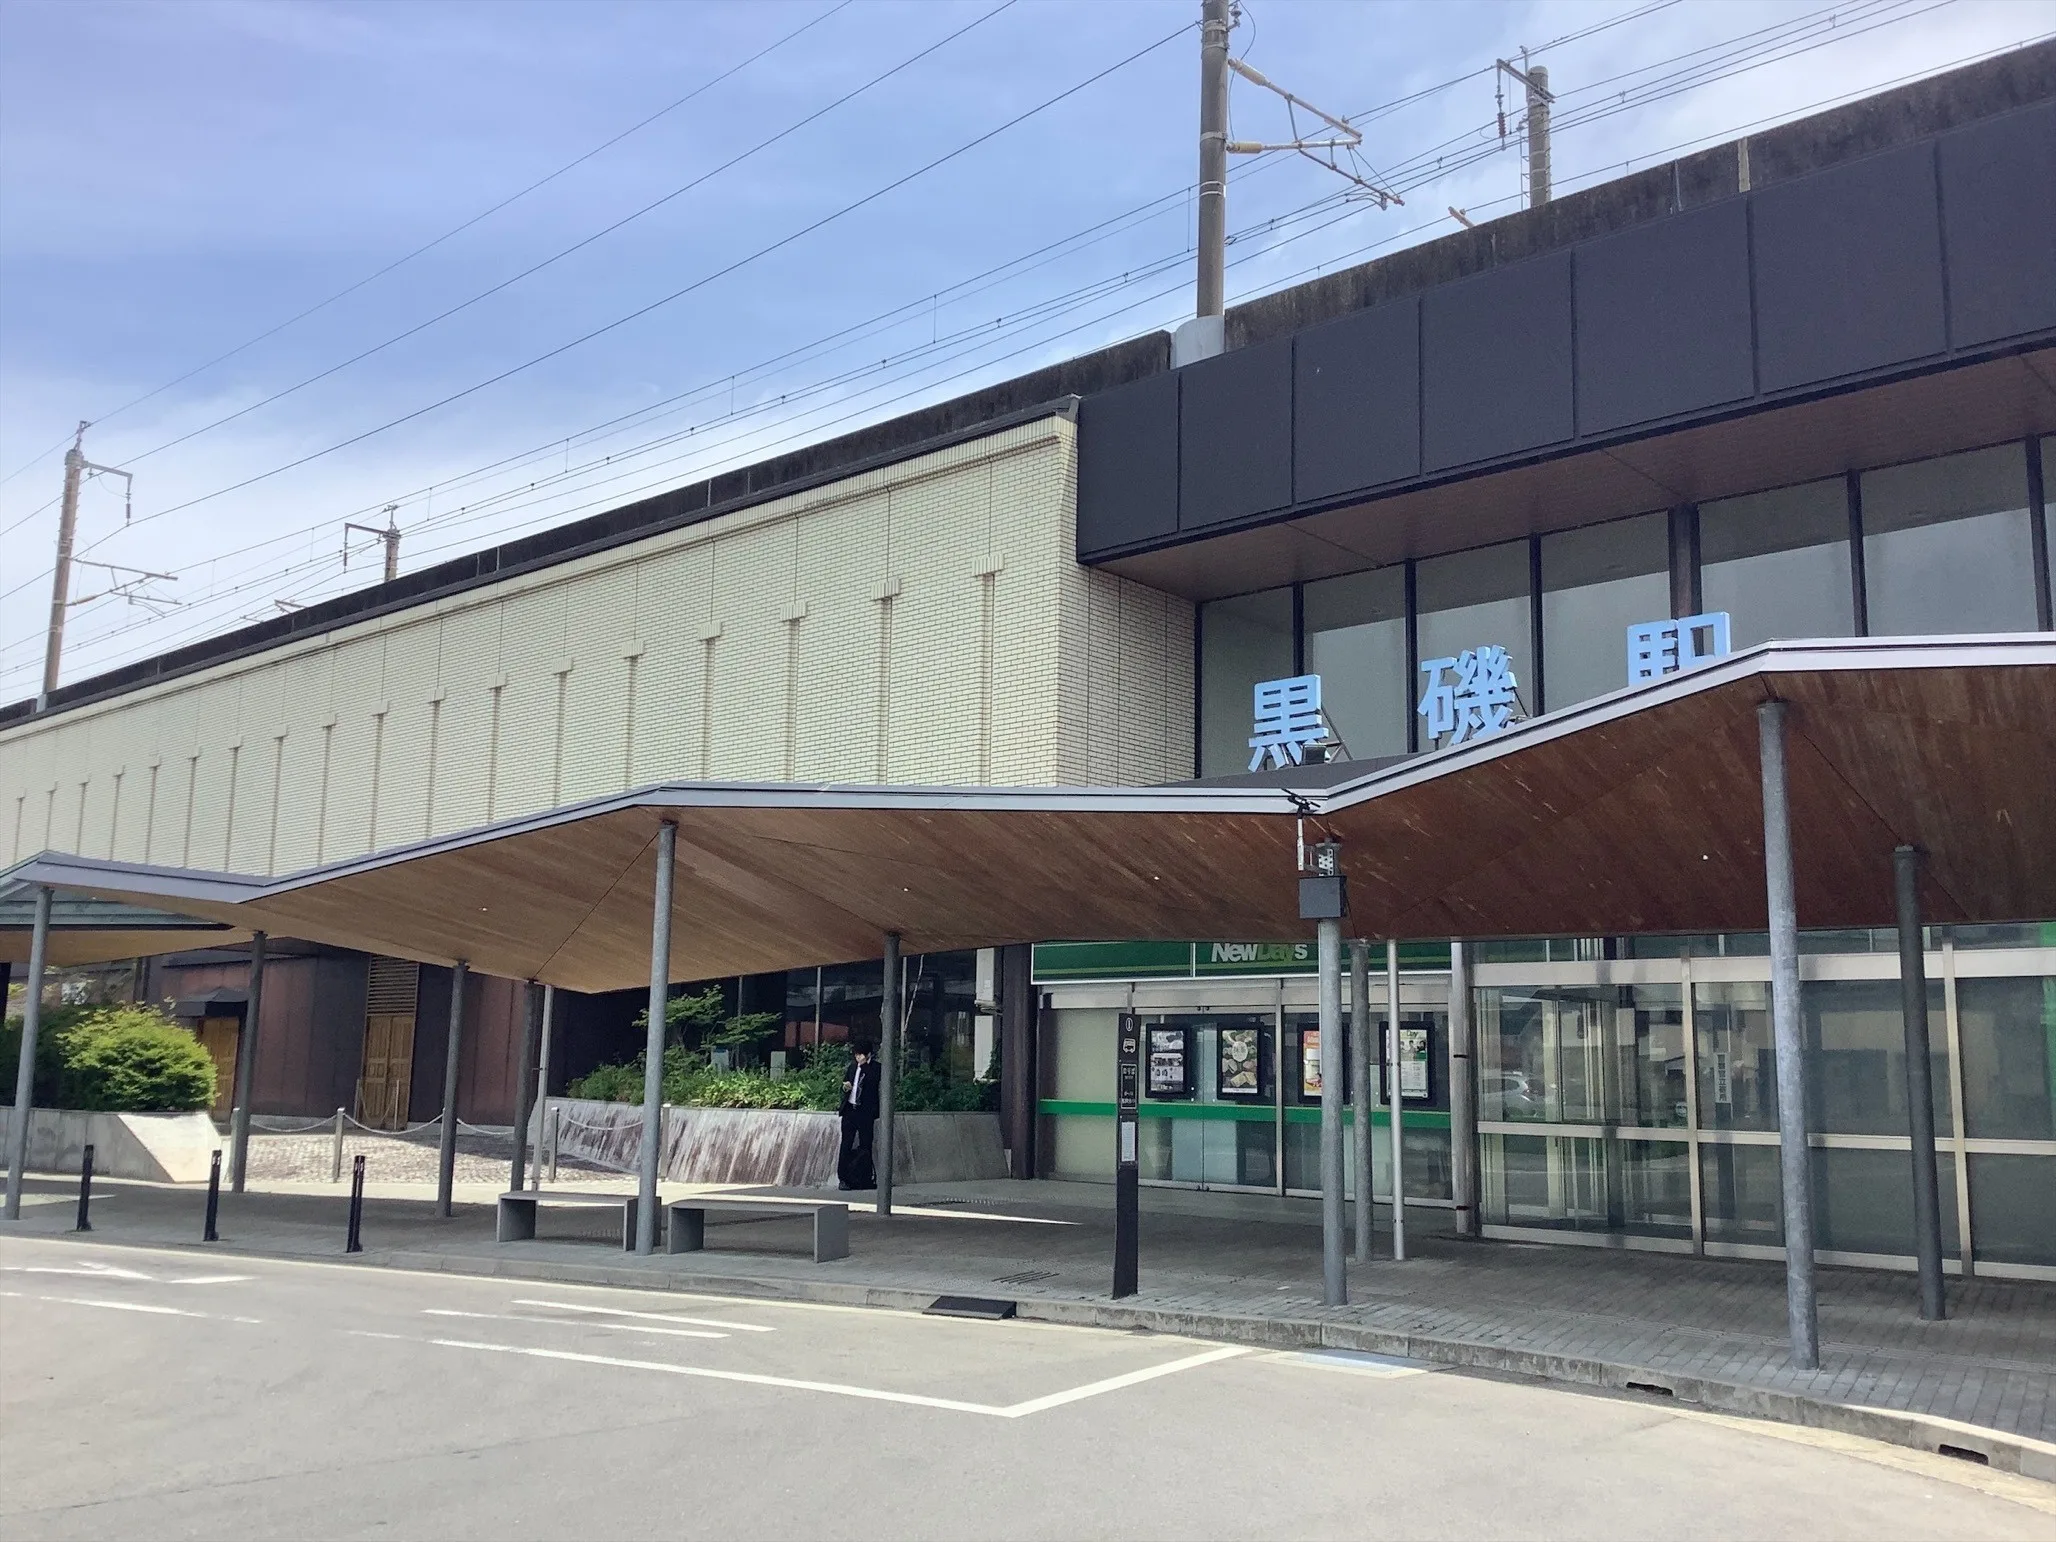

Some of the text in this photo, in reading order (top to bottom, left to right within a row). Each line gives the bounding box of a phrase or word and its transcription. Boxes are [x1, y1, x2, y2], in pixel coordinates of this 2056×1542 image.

[1247, 611, 1731, 773] 黒磯駅
[1211, 942, 1308, 962] NewDays
